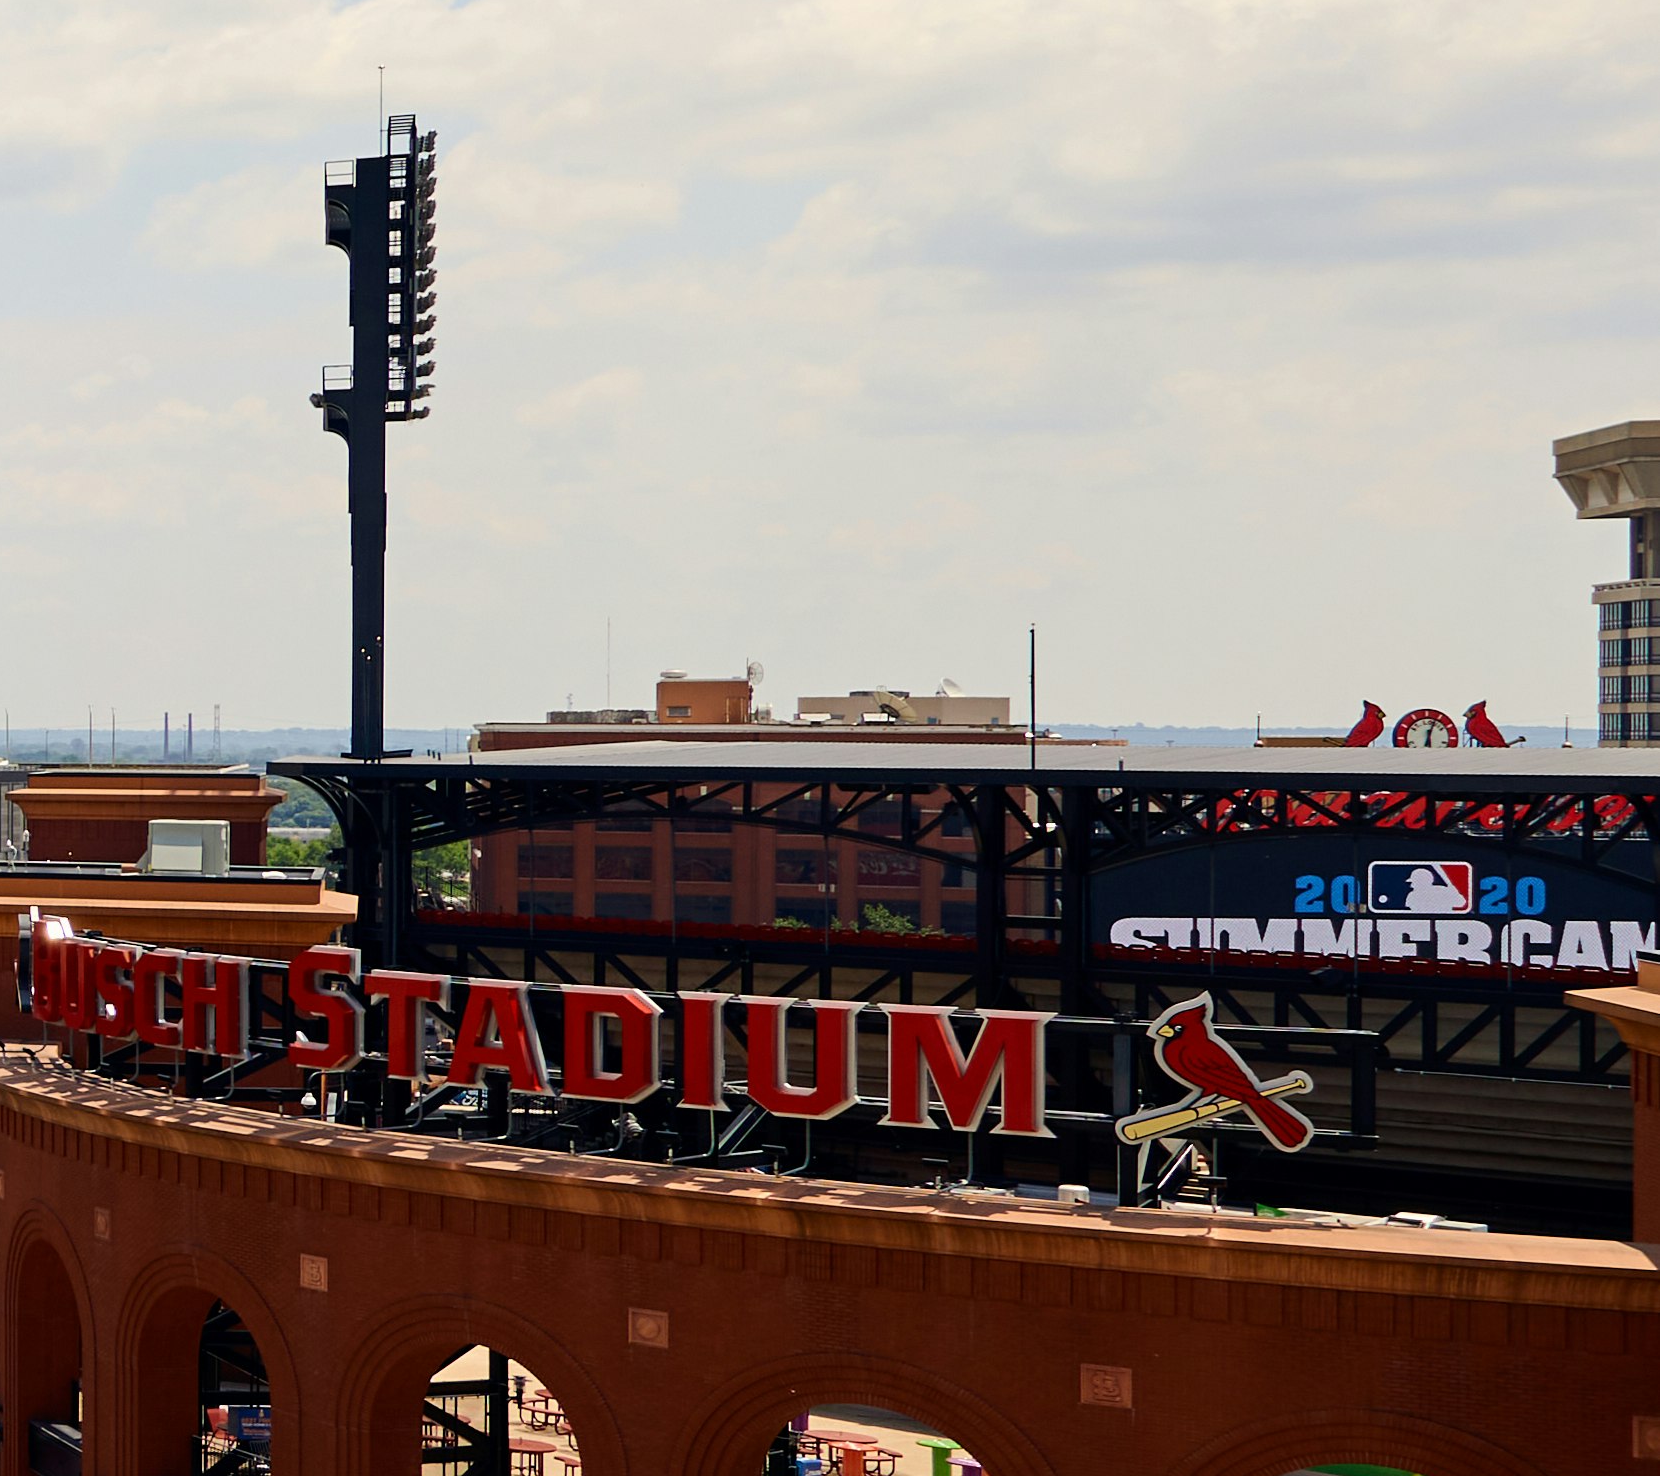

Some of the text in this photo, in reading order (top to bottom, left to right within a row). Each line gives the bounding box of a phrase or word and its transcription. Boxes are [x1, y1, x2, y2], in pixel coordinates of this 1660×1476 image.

[1109, 917, 1494, 965] SUMMER
[30, 912, 1058, 1138] BUSCH STADIUM
